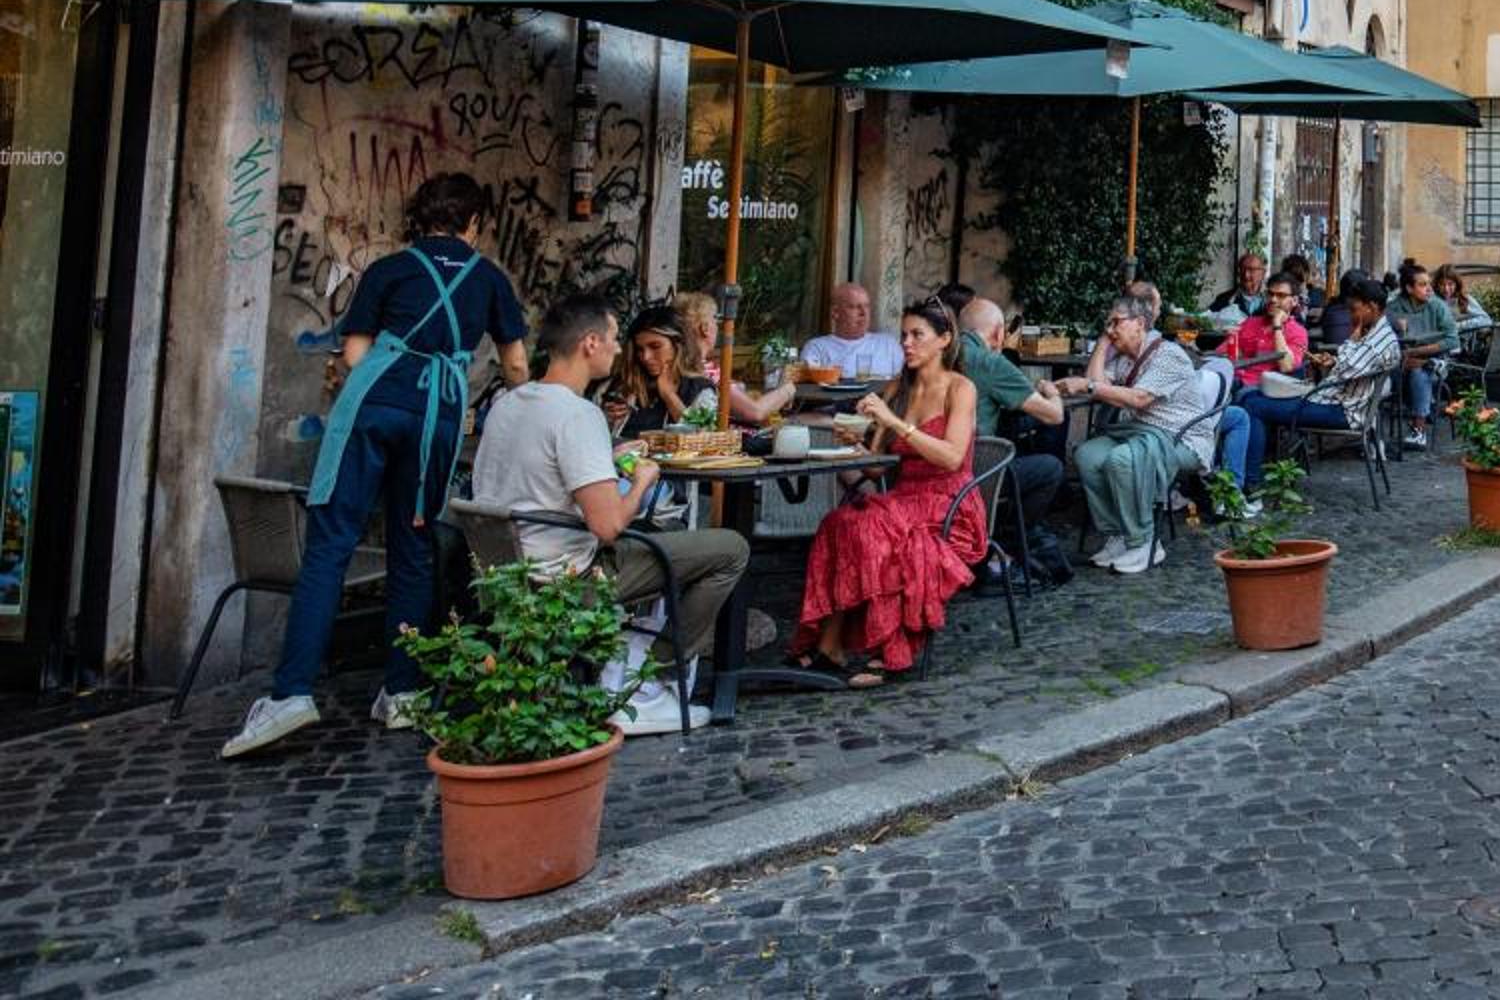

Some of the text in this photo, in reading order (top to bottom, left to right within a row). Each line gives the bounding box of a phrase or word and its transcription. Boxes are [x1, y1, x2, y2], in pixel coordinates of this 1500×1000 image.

[0, 145, 66, 166] timiano
[680, 159, 725, 189] affè
[707, 194, 799, 220] Setimiano
